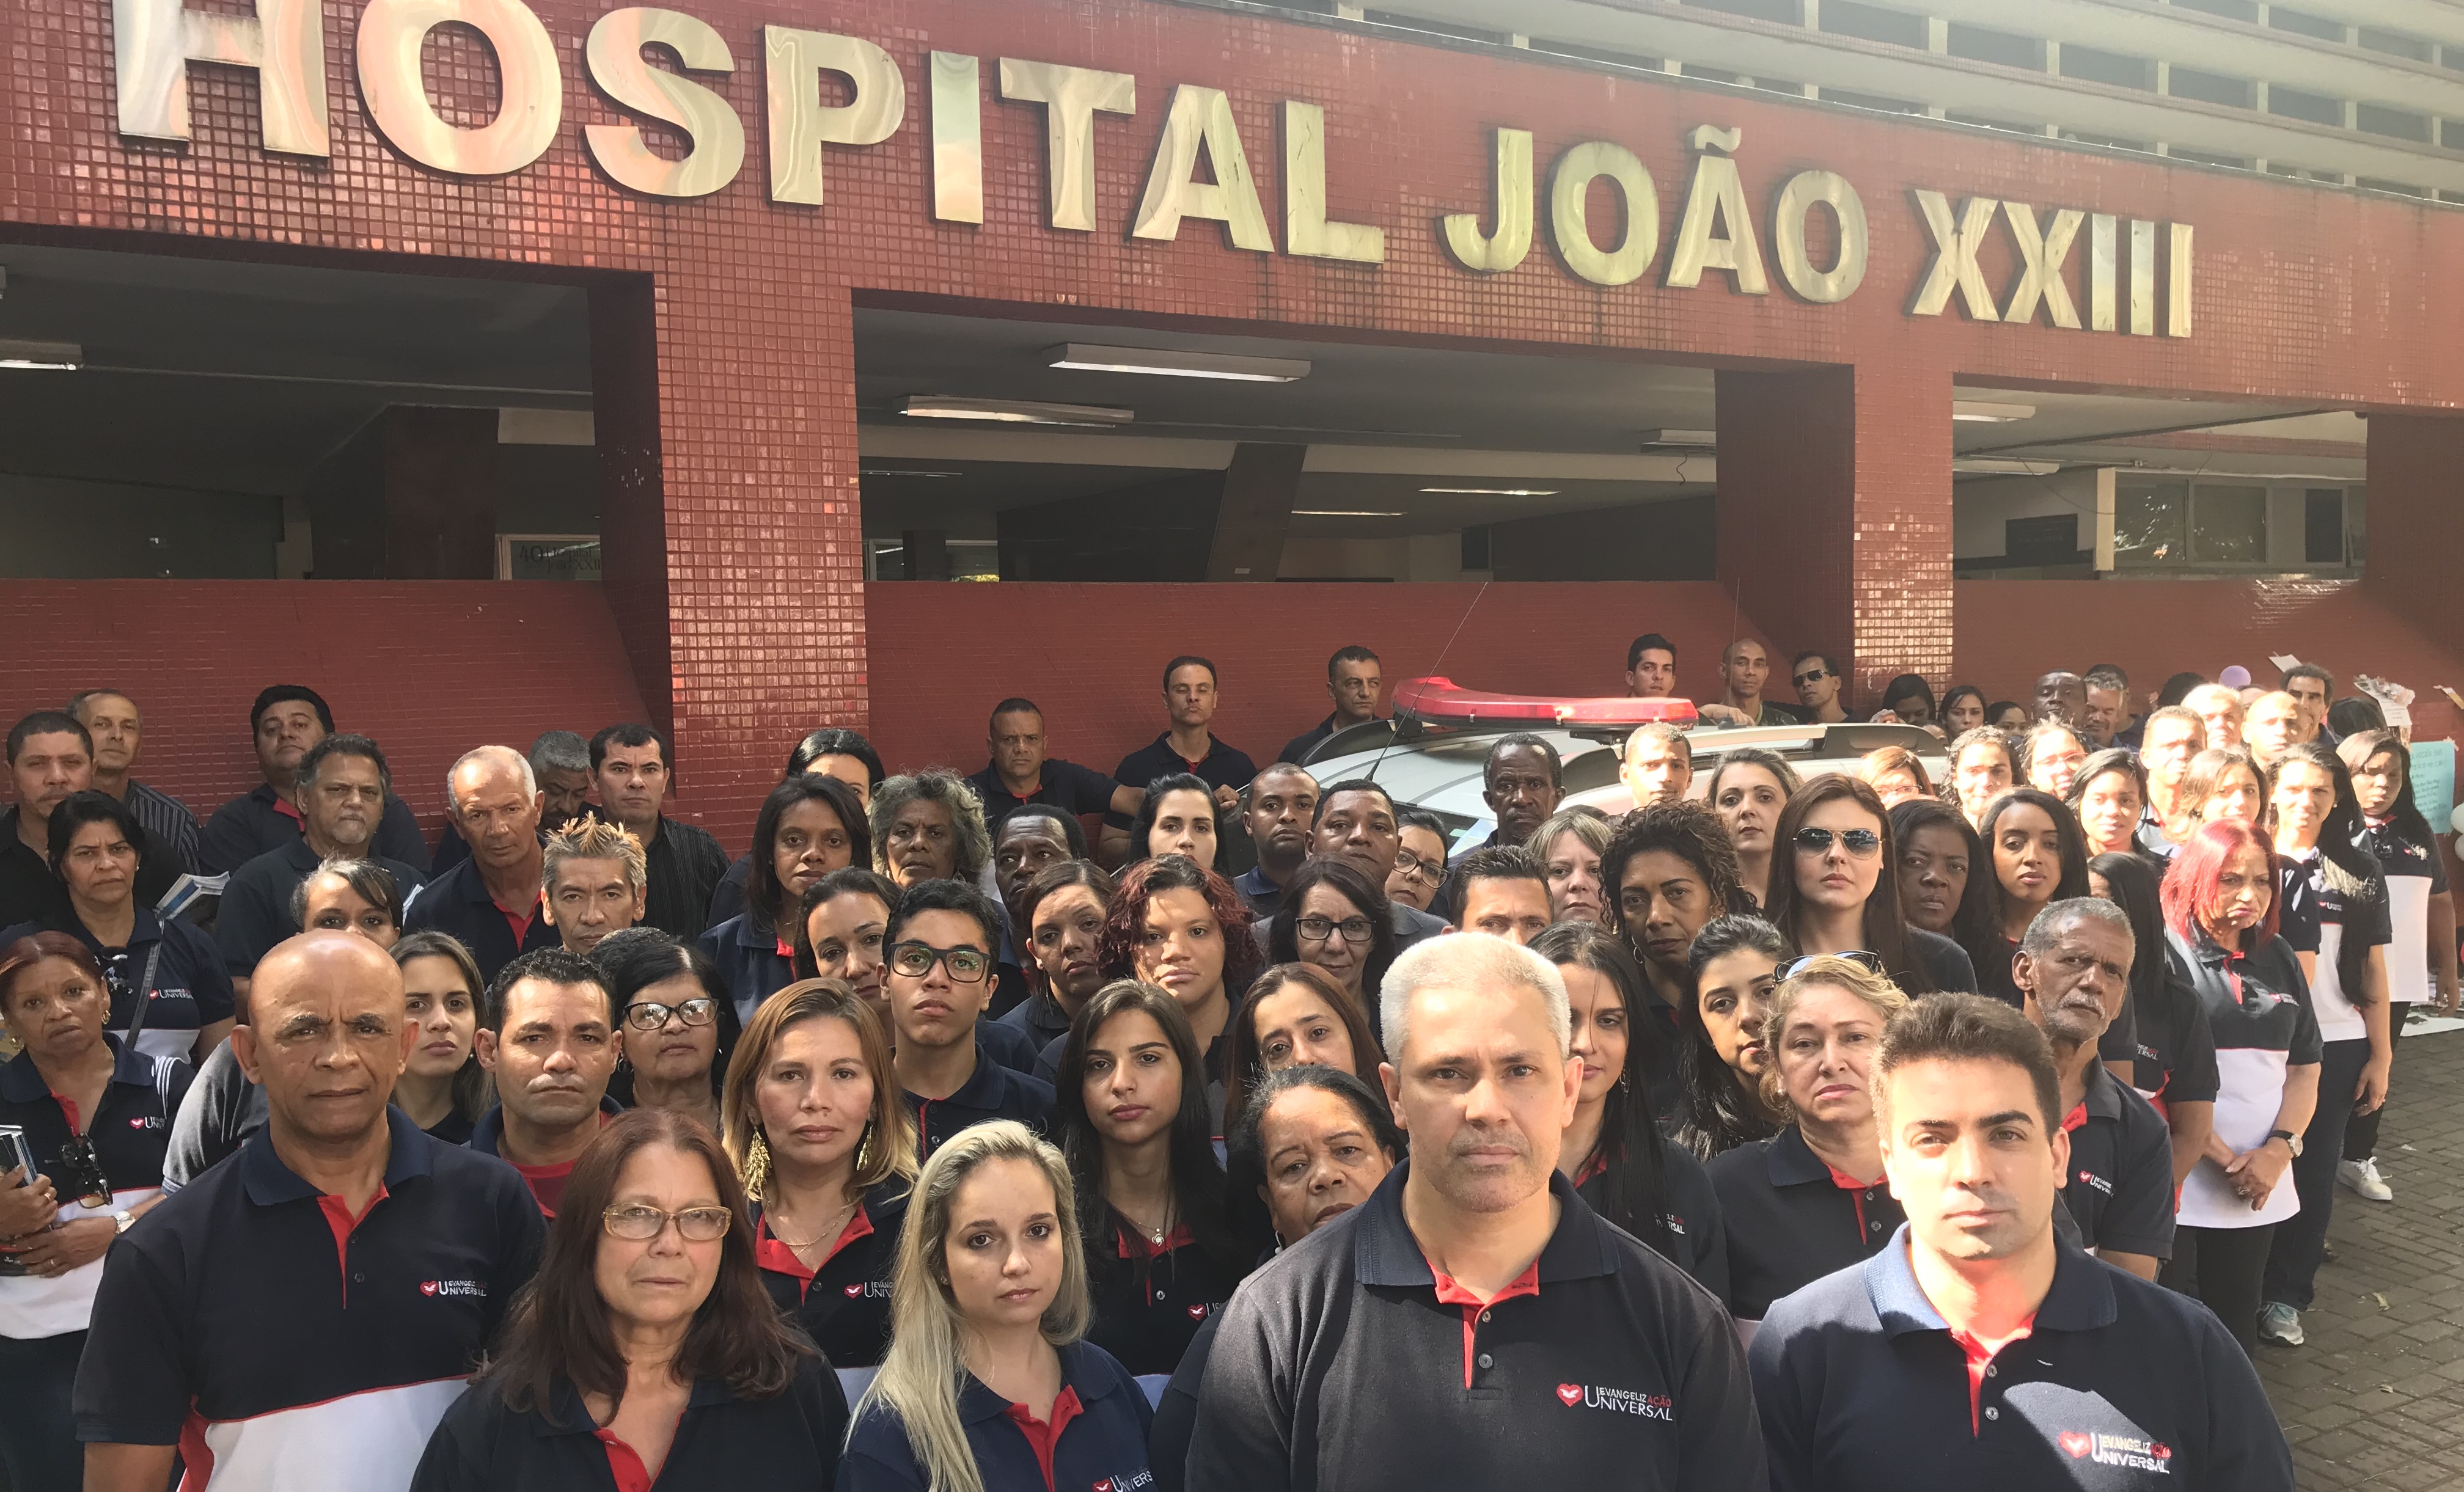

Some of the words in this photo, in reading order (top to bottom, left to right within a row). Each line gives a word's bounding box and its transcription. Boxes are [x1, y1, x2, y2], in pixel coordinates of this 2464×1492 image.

[112, 0, 1385, 263] HOSPITAL
[1440, 124, 1869, 304] JOÃO
[1908, 189, 2194, 338] XXIII
[1585, 1385, 1673, 1421] UNIVERSAL
[1599, 1387, 1671, 1408] EVANGELIZAÇÃO
[2090, 1432, 2170, 1474] UNIVERSAL
